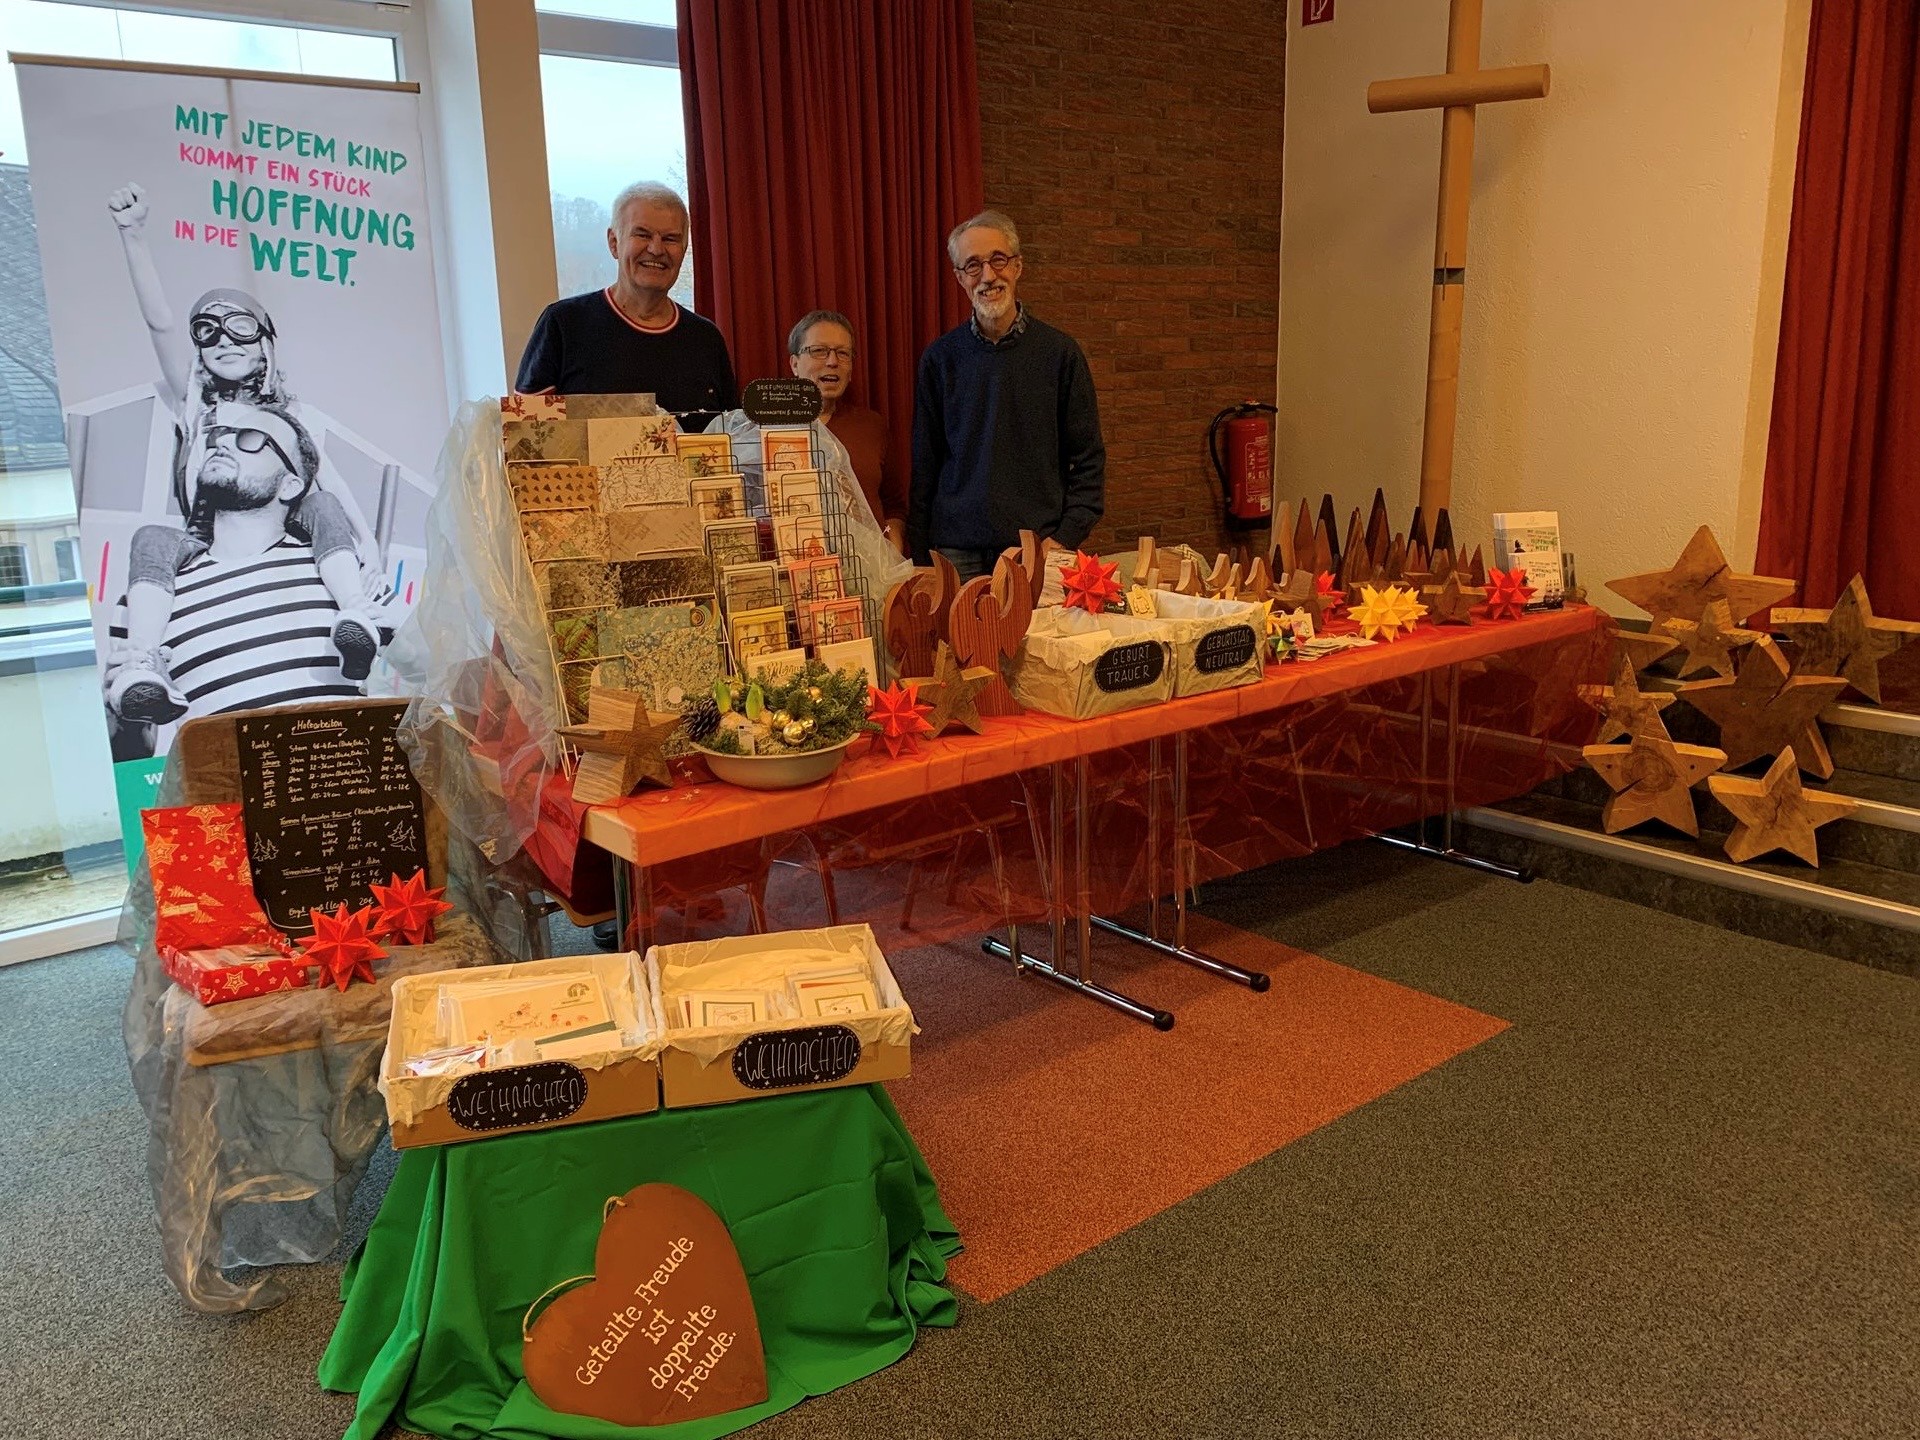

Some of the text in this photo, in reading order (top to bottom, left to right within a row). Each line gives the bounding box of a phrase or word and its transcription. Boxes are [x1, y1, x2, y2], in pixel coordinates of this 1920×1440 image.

[175, 104, 408, 175] MIT JEDEM KIND
[179, 142, 371, 197] KOMMT EIN STÜCK
[211, 179, 415, 251] HOFFNUNG
[174, 220, 358, 287] IN DIE WELT.
[1112, 645, 1150, 665] GEBURT
[1205, 650, 1245, 669] NEUTRAL
[1207, 629, 1250, 650] GEBURTSTAG
[1107, 665, 1150, 685] TRAUER
[744, 1034, 855, 1082] WEIHNACHTEN
[456, 1077, 581, 1118] WEIHNACHTEN
[576, 1237, 694, 1385] Geteilte Freude
[641, 1308, 675, 1345] ist
[648, 1303, 718, 1390] doppelte
[674, 1331, 737, 1403] Freude.
